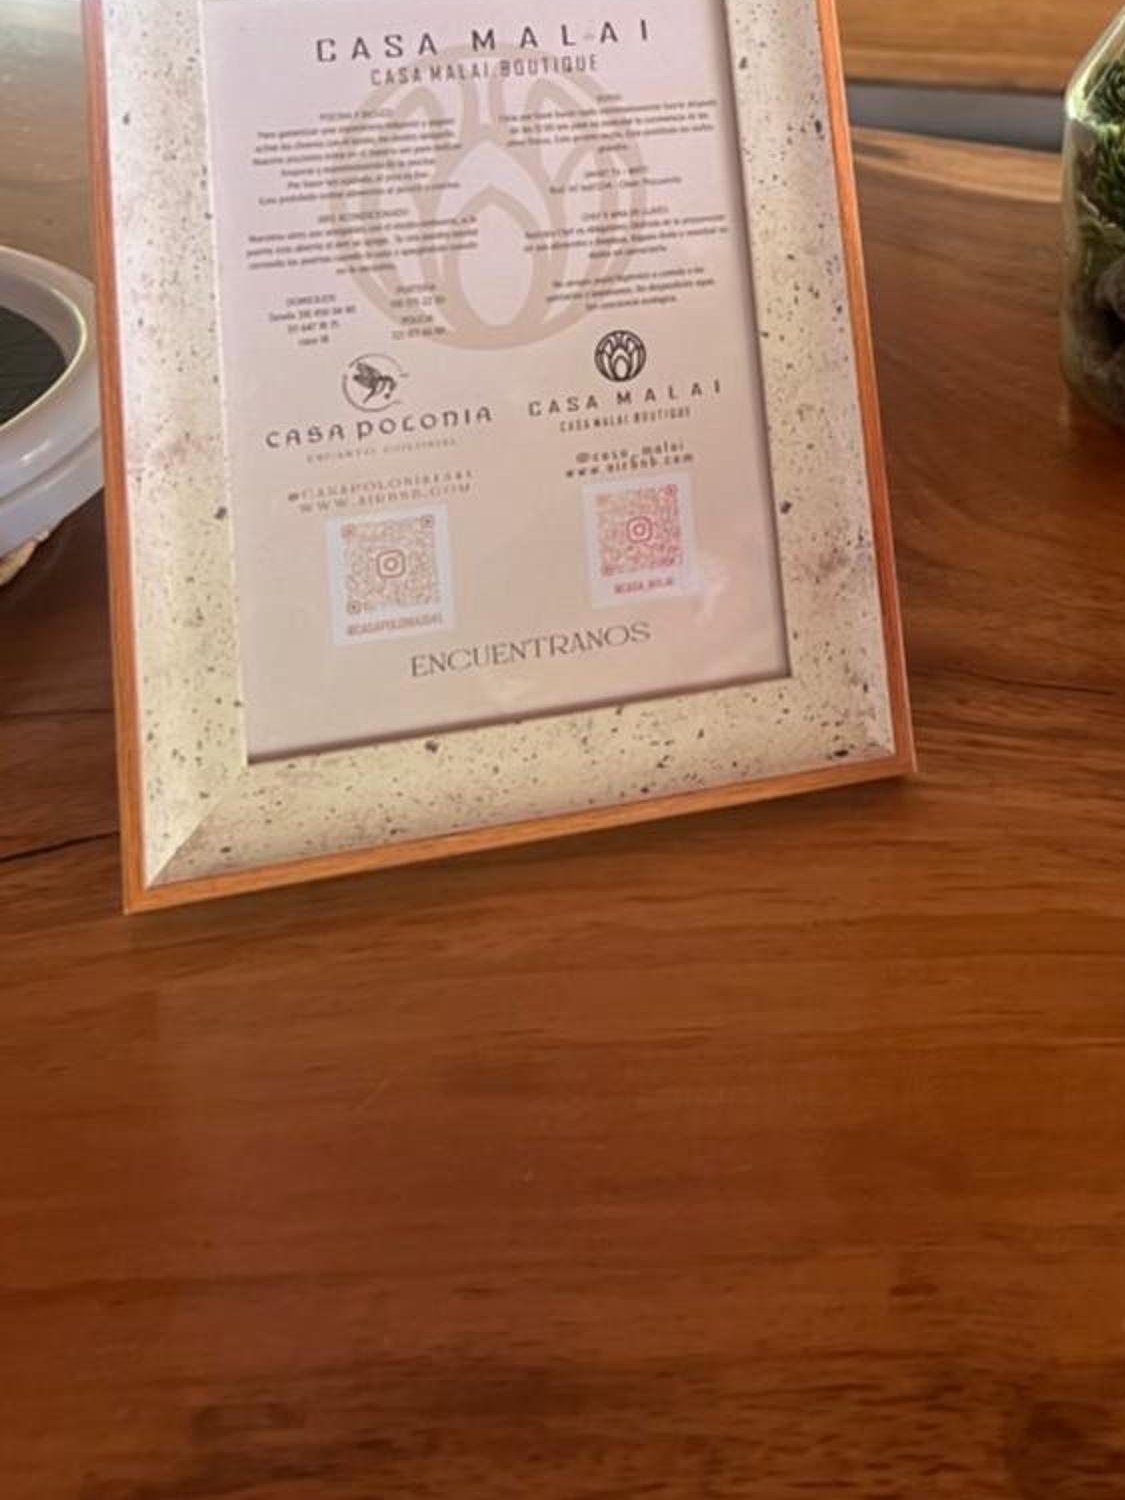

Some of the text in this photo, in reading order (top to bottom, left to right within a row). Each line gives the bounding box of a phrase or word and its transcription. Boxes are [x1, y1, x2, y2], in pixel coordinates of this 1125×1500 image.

[315, 18, 650, 63] CASA MALAI
[371, 53, 599, 87] CASA MALAI BOUTIQUE
[529, 378, 721, 417] CASA MALAI
[265, 406, 493, 449] CASA POLONIA
[410, 621, 652, 678] ENCUENTRANOS
